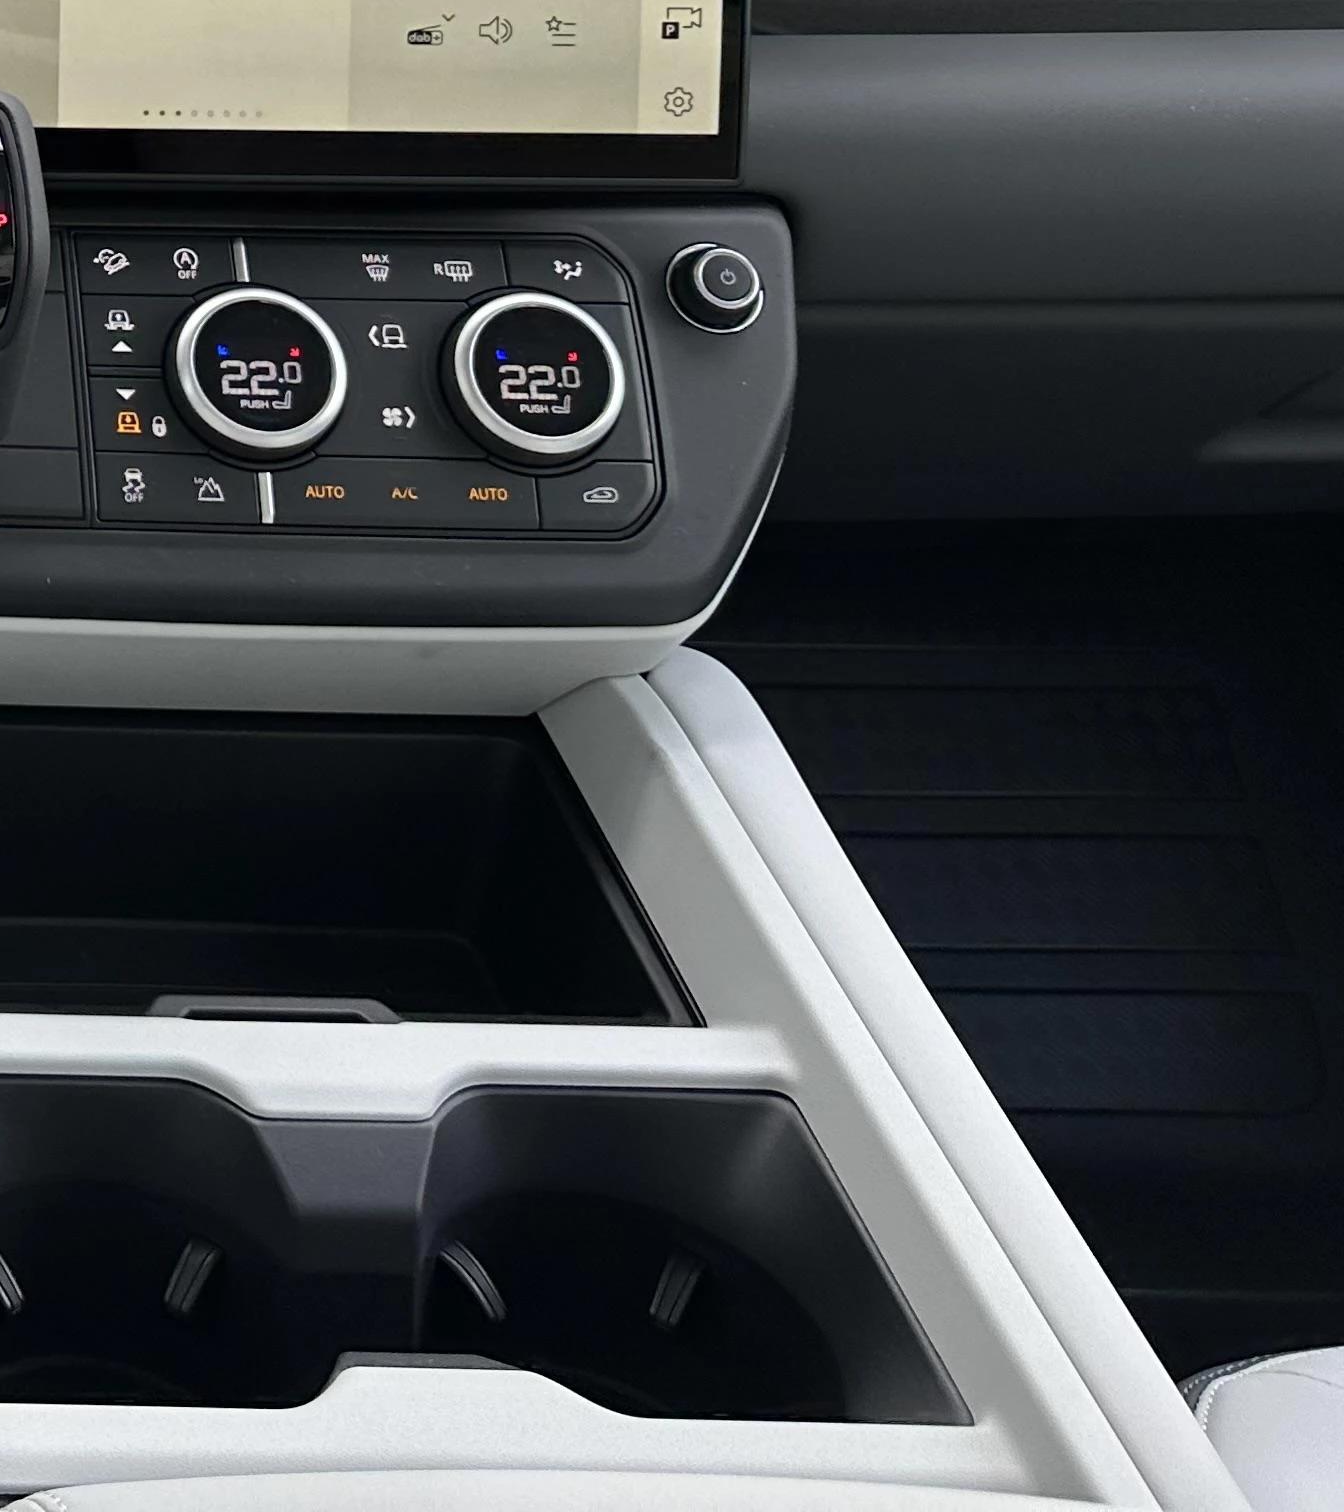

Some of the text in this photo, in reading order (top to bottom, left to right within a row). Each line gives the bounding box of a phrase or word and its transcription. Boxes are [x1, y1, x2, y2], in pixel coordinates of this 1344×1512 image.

[362, 254, 389, 264] MAX
[177, 270, 198, 279] OFF
[434, 264, 443, 276] R
[219, 360, 302, 396] 22.0
[498, 364, 581, 400] 22.0
[240, 400, 269, 409] PUSH
[520, 404, 549, 414] PUSH
[124, 493, 144, 503] OFF
[305, 485, 345, 499] AUTO
[391, 487, 418, 499] A/C
[468, 487, 508, 501] AUTO
